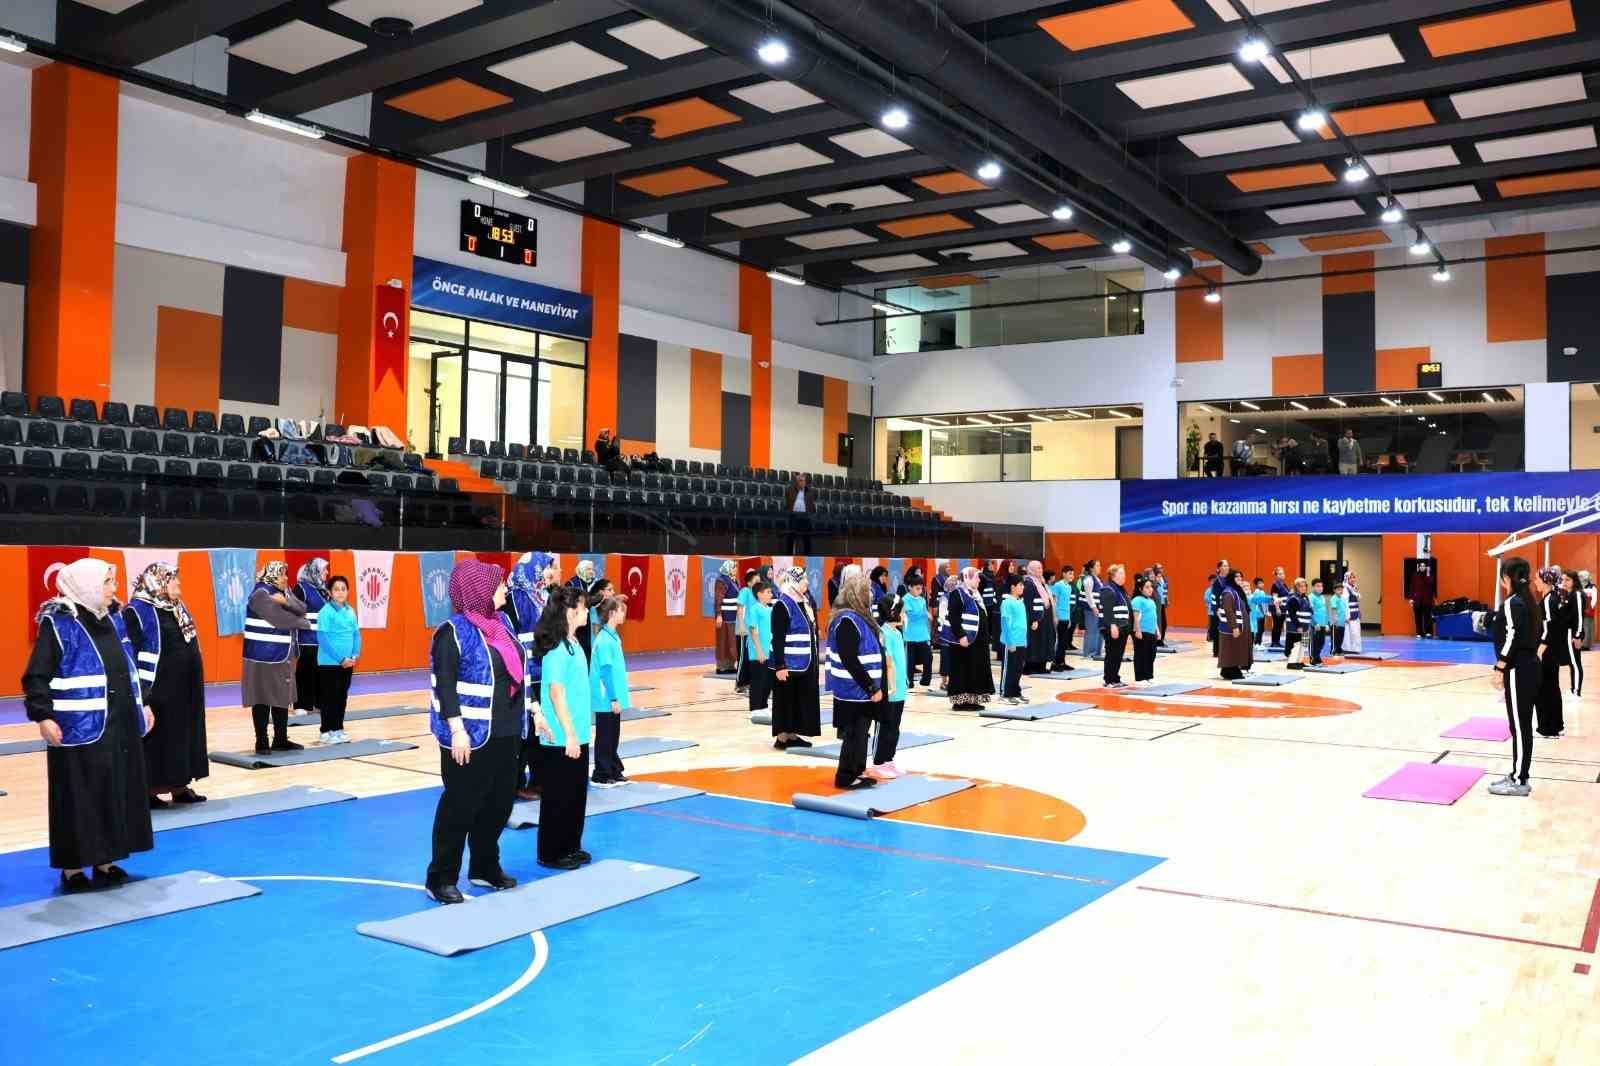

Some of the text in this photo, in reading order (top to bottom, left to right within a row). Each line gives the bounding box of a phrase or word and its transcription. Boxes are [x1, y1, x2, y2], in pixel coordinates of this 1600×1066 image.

[474, 204, 481, 218] 0
[528, 218, 534, 231] 0
[468, 235, 475, 252] 0
[524, 250, 531, 264] 0
[432, 276, 579, 320] ÖNCE AHLAK VE MANEVİYAT
[1162, 499, 1189, 516] Spor
[1192, 501, 1208, 515] ne
[1211, 499, 1267, 515] kazanma
[1270, 498, 1300, 514] hırsı
[1303, 500, 1320, 514] ne
[1323, 497, 1390, 516] kaybetme
[1394, 496, 1482, 515] korkusudur,
[1486, 495, 1510, 512] tek
[1513, 494, 1588, 514] kelimeyle
